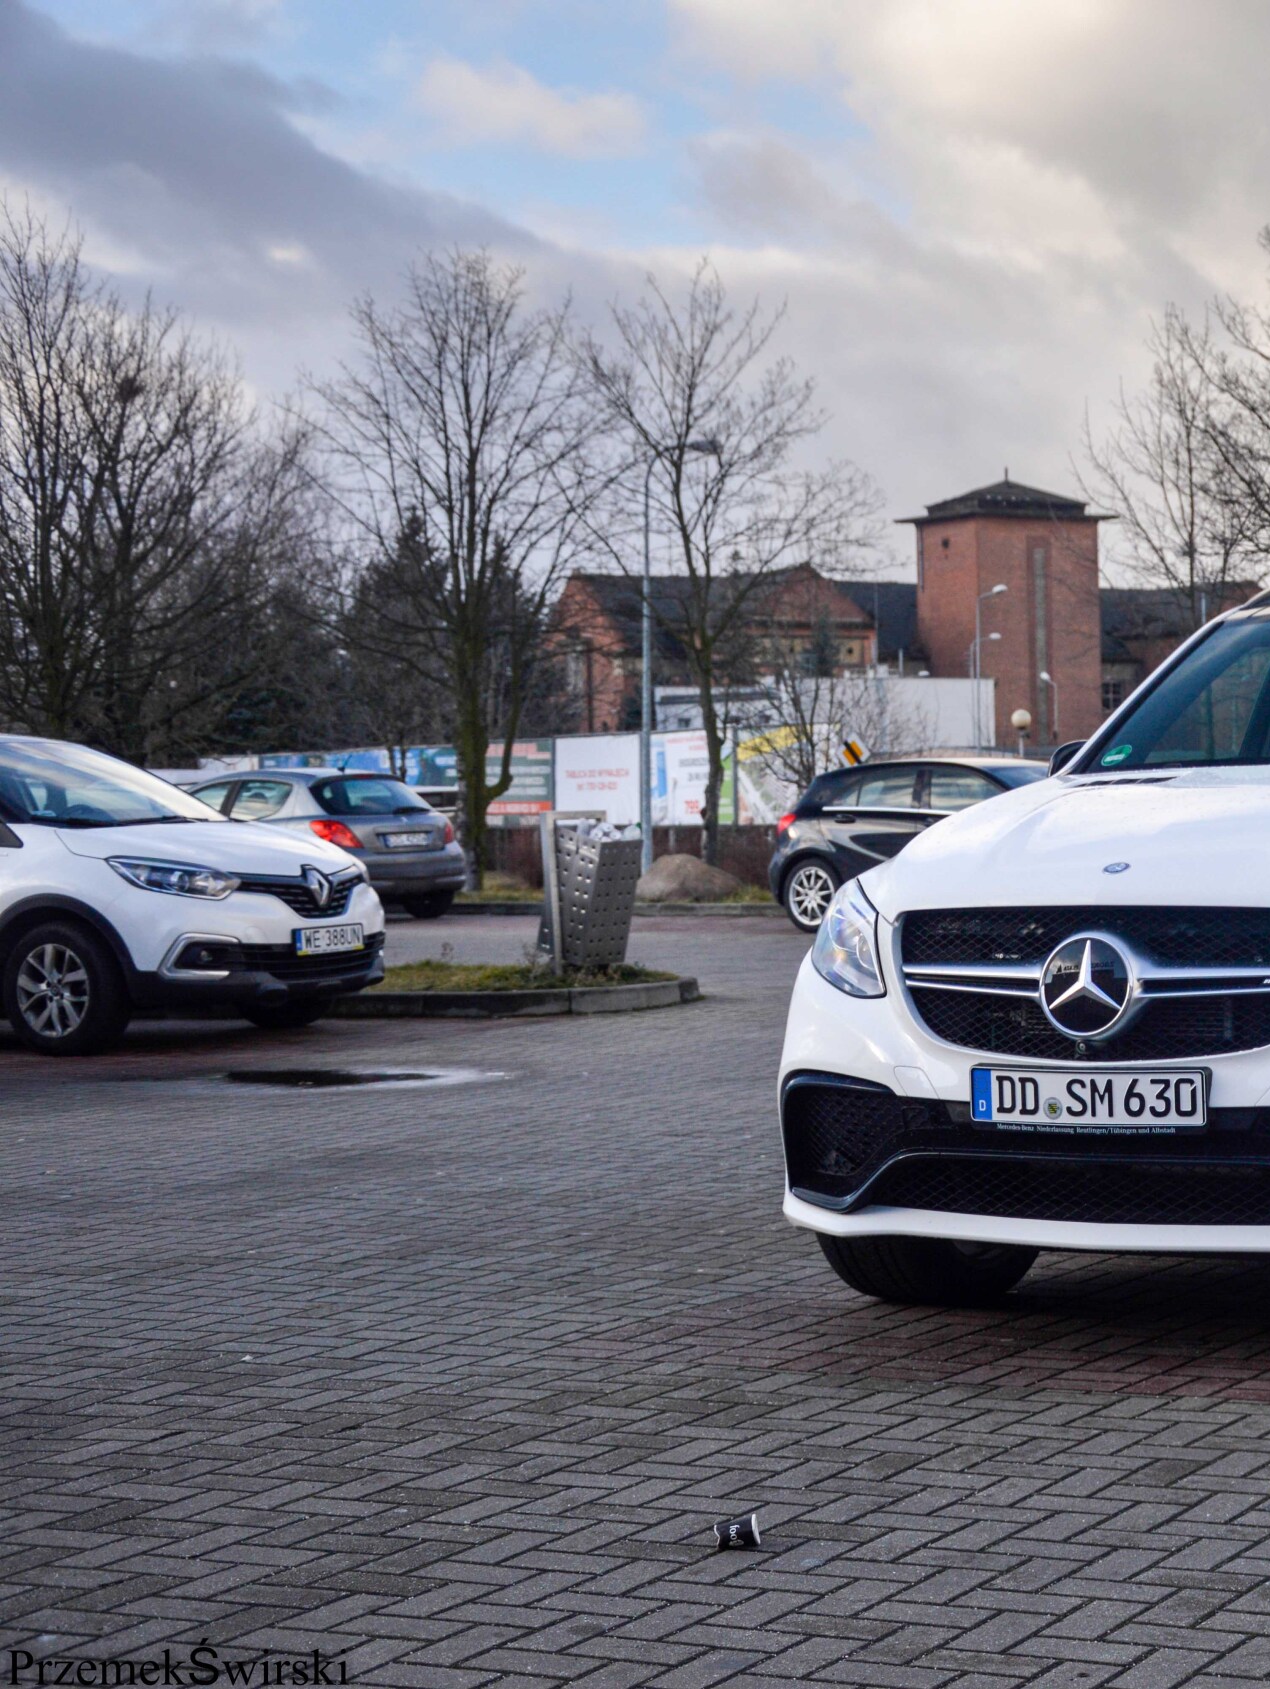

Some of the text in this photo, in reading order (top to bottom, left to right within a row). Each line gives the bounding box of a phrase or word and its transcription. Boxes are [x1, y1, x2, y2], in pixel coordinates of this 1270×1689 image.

[304, 926, 361, 949] WE 388UN
[996, 1075, 1197, 1118] DD SM 630
[978, 1100, 987, 1111] D
[997, 1123, 1034, 1132] Mercedes-Benz
[1036, 1125, 1075, 1134] Niederlassung
